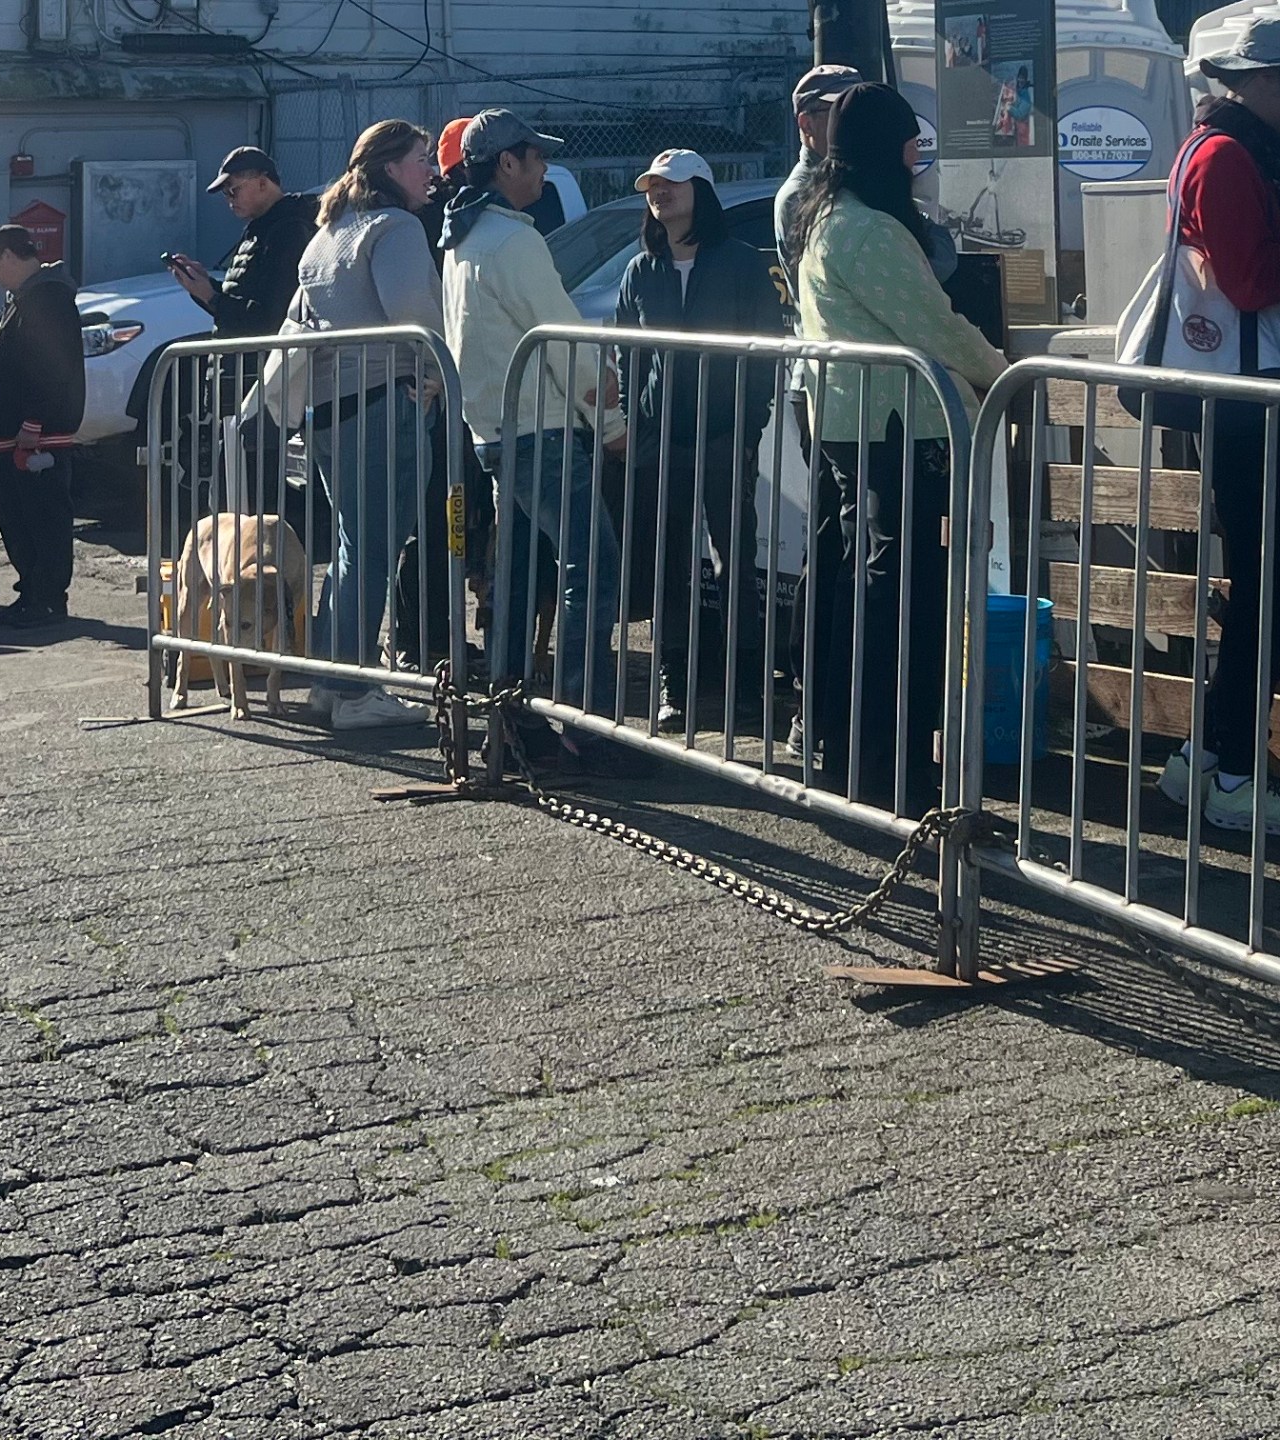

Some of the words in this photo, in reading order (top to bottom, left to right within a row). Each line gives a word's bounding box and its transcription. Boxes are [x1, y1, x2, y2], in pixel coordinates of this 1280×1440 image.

[1071, 122, 1103, 132] Reliable
[1070, 134, 1103, 147] Onsite
[1105, 134, 1147, 147] Services
[36, 225, 58, 233] ALARM
[451, 484, 464, 540] rentals
